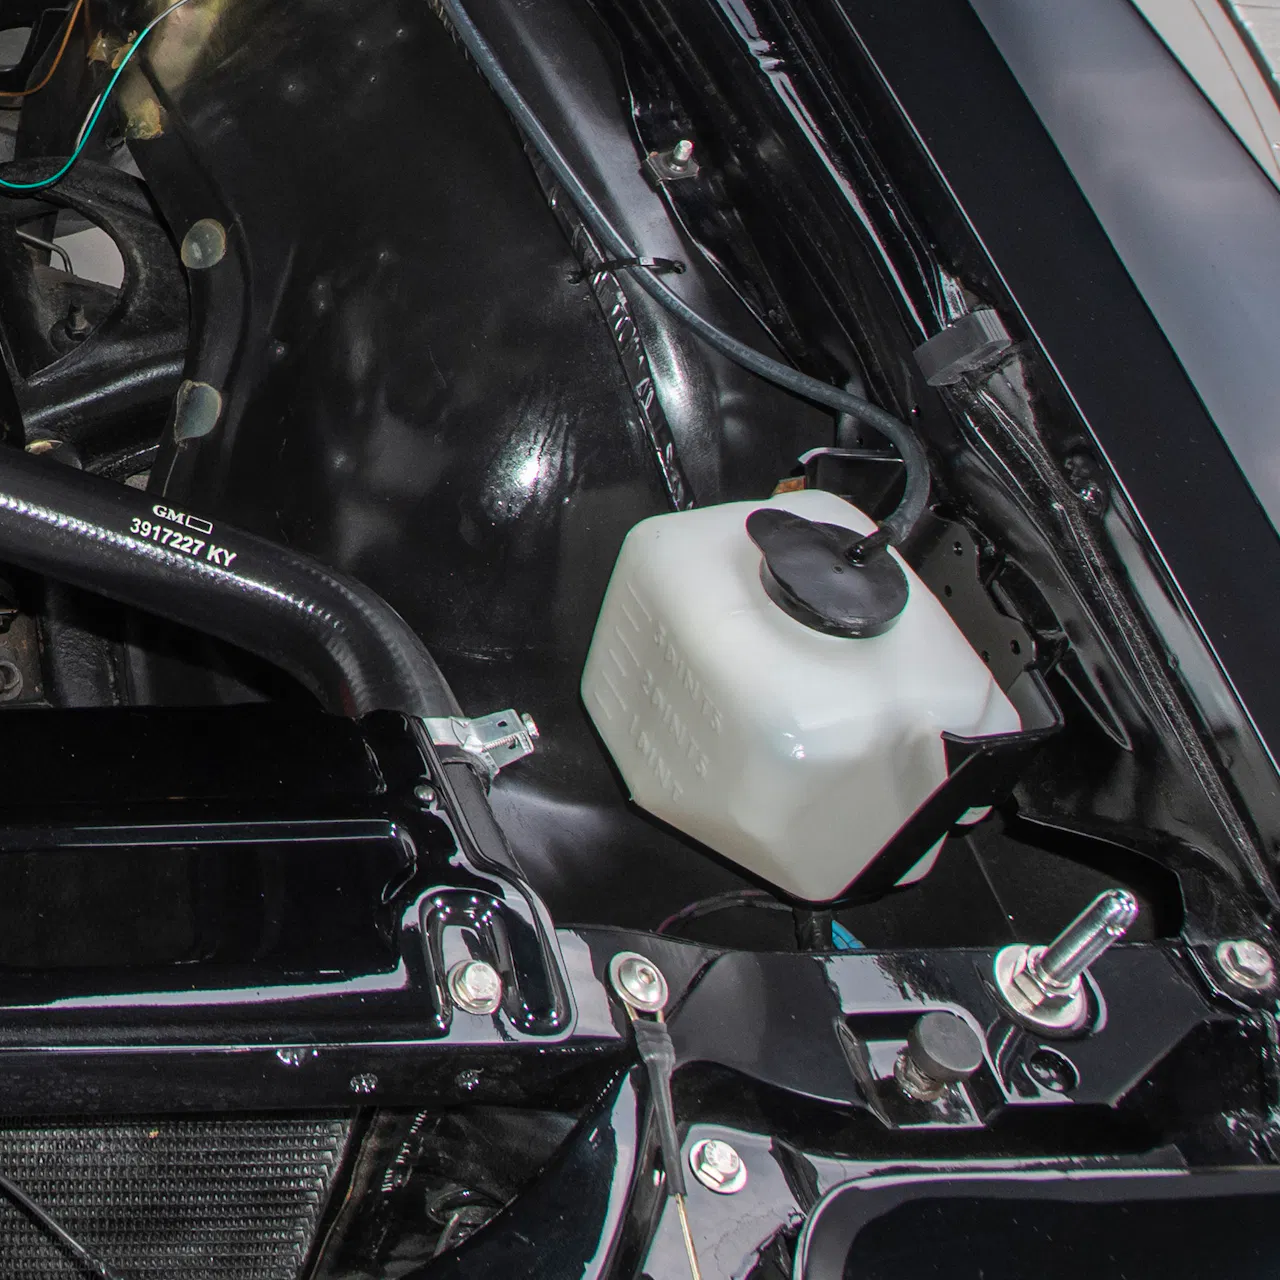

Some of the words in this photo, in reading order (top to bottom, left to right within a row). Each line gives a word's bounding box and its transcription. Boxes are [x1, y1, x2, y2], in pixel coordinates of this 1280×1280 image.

[152, 504, 186, 525] GM
[130, 517, 206, 556] 3917227
[206, 544, 237, 567] KY
